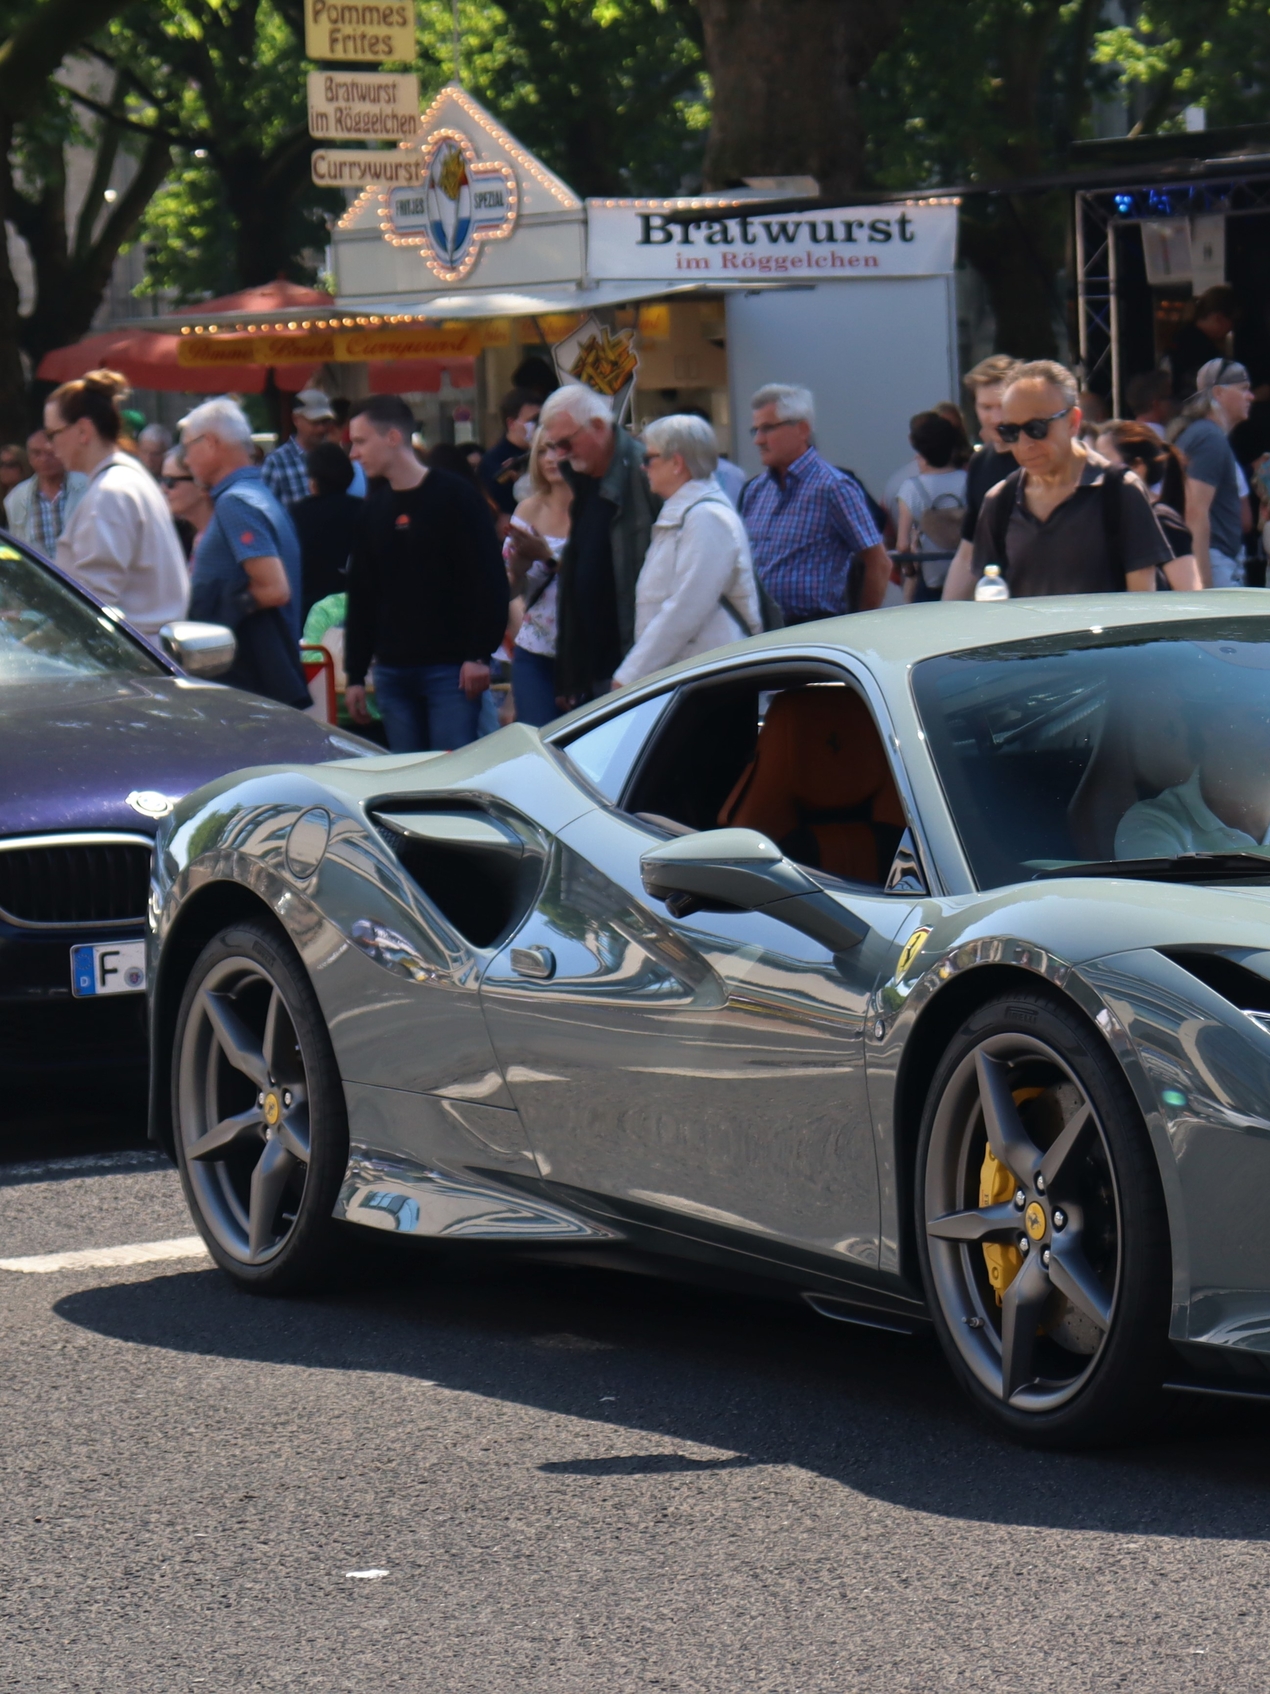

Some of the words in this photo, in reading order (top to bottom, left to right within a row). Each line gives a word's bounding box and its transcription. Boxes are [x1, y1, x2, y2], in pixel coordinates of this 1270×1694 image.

[312, 0, 408, 27] Pommes
[328, 27, 393, 55] Frites
[324, 75, 397, 104] Bratwurst
[310, 106, 329, 133] im
[334, 107, 417, 135] Röggelchen
[312, 154, 421, 182] Currywurst
[473, 190, 505, 210] SPEZIAL
[635, 209, 915, 246] Bratwurst
[676, 252, 711, 270] im
[720, 250, 880, 273] Röggelchen
[80, 976, 91, 987] D
[99, 950, 120, 987] F
